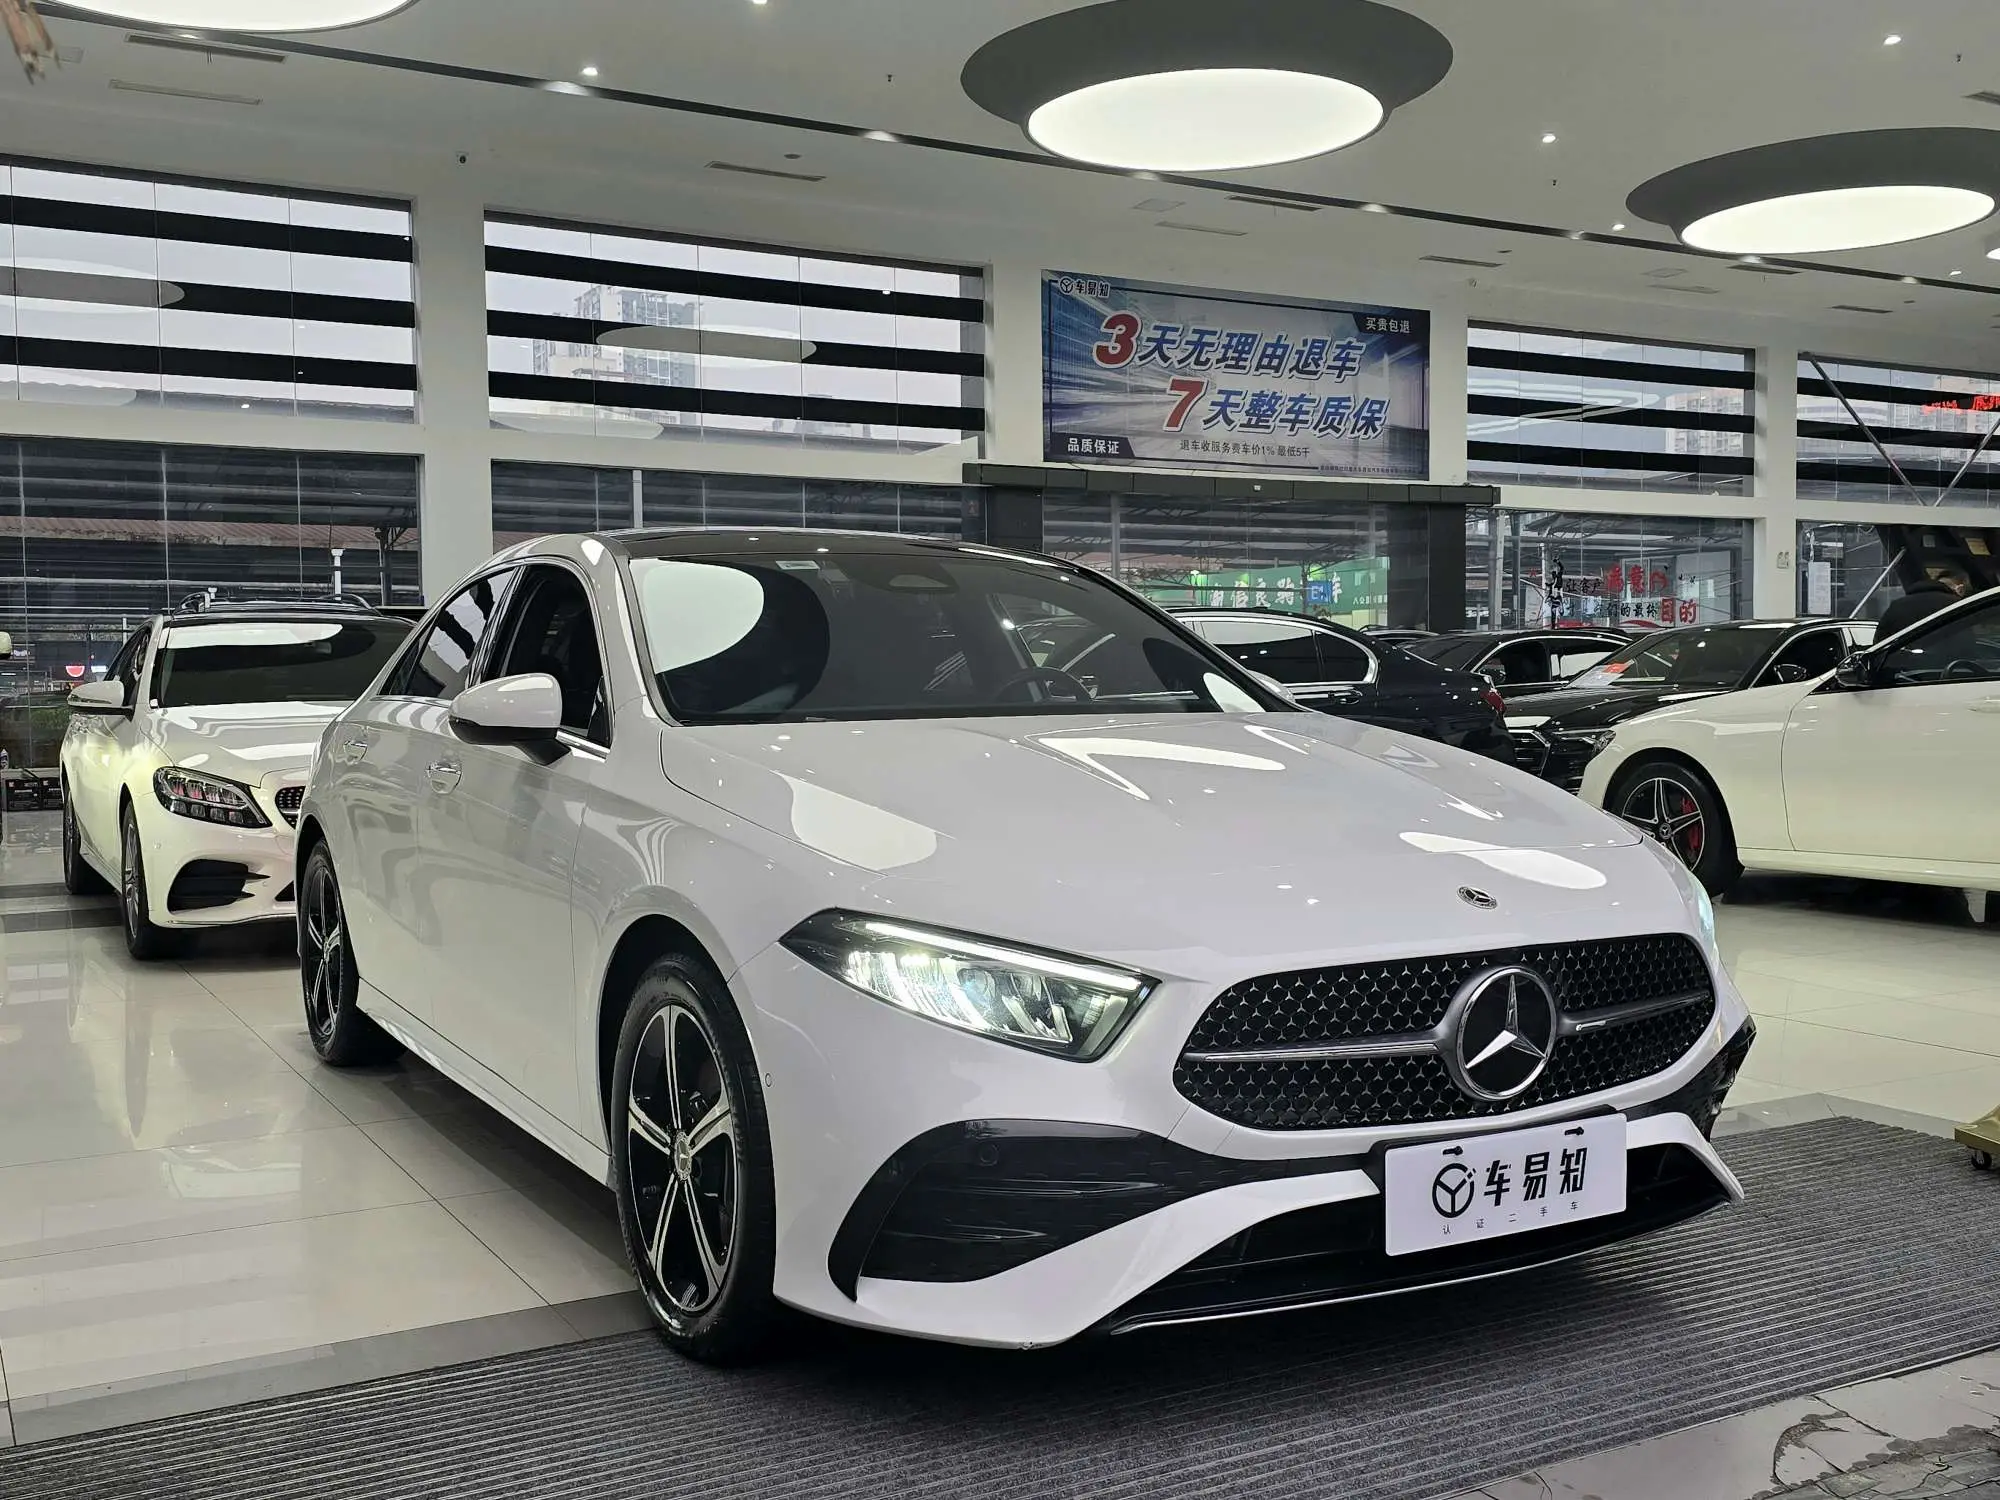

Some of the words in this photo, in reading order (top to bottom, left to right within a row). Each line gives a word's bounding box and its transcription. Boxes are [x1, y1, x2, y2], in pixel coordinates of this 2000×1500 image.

[1075, 279, 1109, 297] 车易知
[1366, 317, 1410, 334] 买贵包退
[1094, 311, 1366, 381] 3天无理由退车
[1164, 376, 1388, 439] 7天整车质保
[1067, 437, 1120, 454] 品质保证
[1484, 1147, 1588, 1207] 车易知
[1442, 1201, 1578, 1235] 认证二手车
